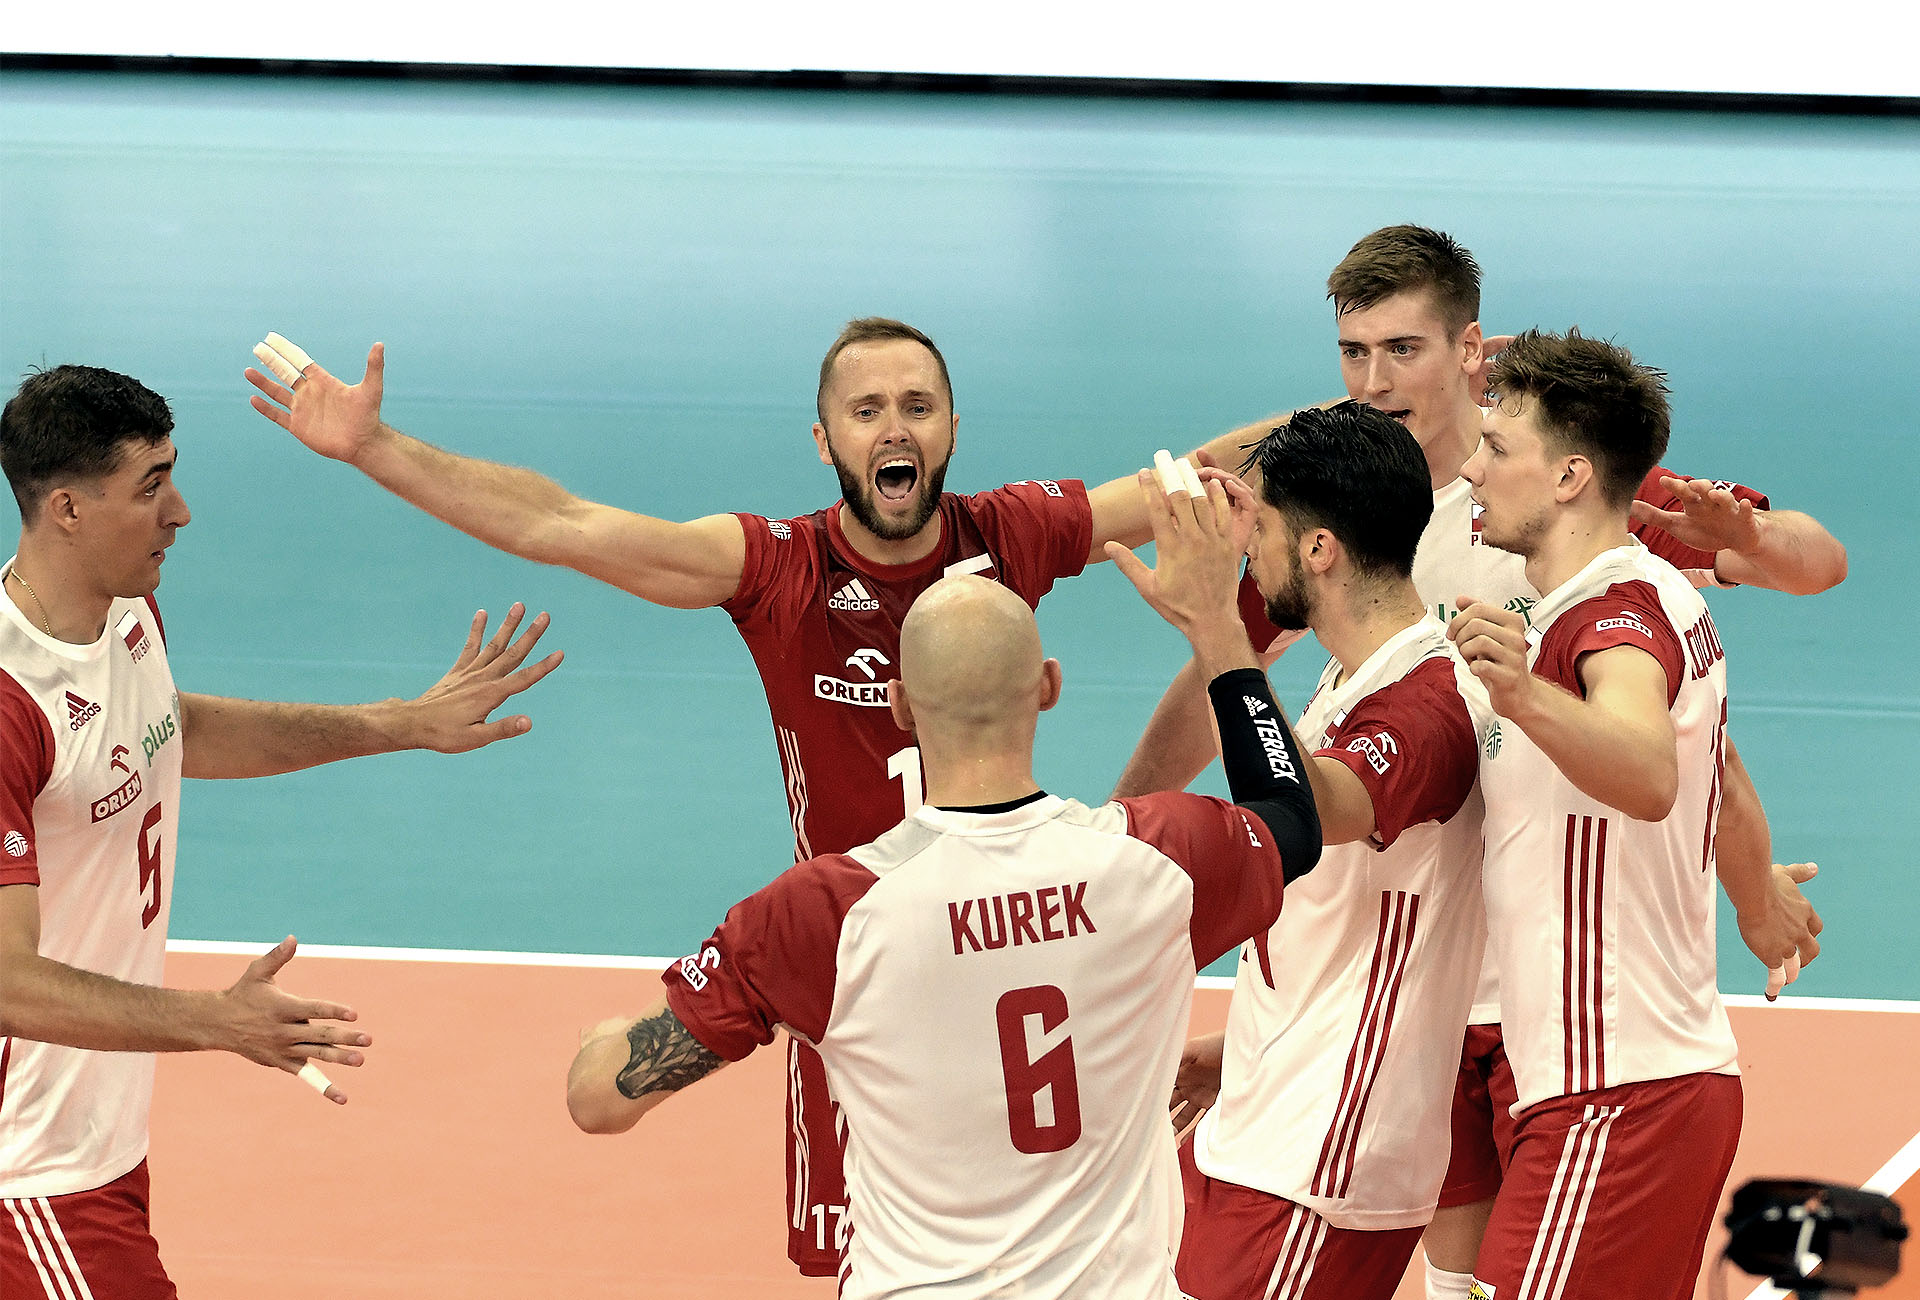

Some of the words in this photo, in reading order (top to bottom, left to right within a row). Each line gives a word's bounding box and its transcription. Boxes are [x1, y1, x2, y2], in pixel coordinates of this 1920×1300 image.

[828, 598, 880, 611] adidas
[819, 680, 888, 703] ORLEN
[70, 702, 102, 731] adidas
[141, 713, 175, 768] plus
[1253, 717, 1300, 785] TERREX
[1351, 739, 1386, 770] ORLEN
[94, 774, 142, 818] ORLEN
[137, 801, 162, 930] 5
[947, 881, 1097, 955] KUREK
[996, 984, 1082, 1155] 6
[812, 1203, 846, 1250] 17
